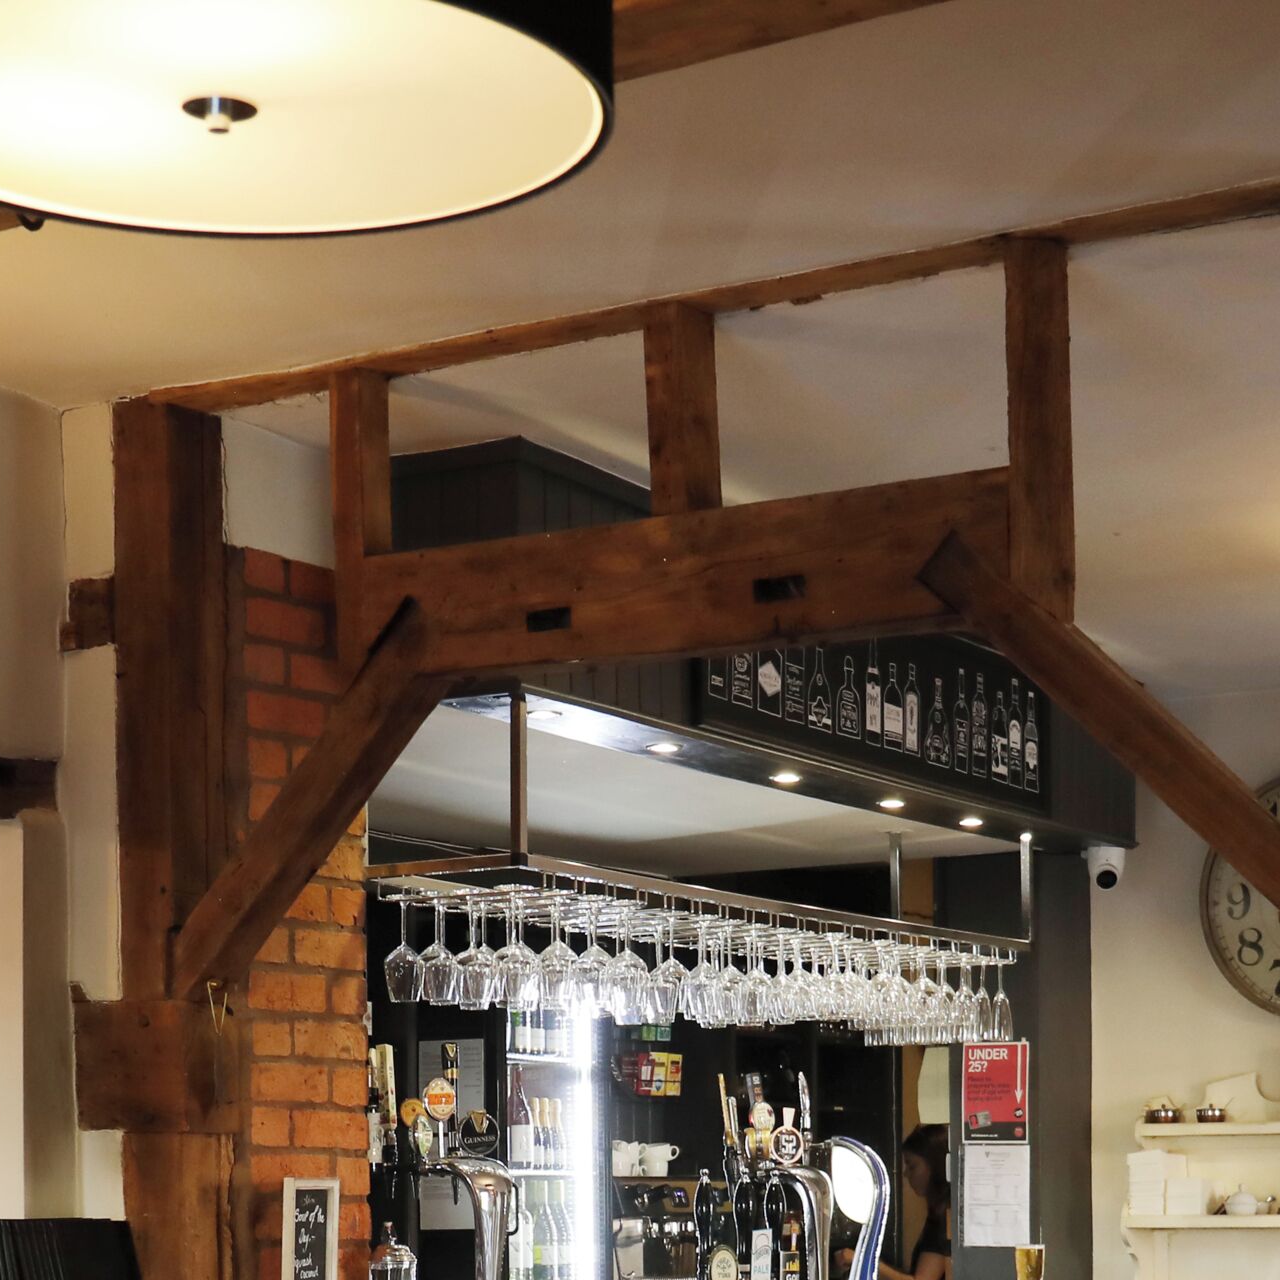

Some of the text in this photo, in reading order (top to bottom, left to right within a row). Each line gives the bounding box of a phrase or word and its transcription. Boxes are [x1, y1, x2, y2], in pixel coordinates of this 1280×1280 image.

[1227, 882, 1251, 920] 9
[1237, 927, 1264, 967] 8
[968, 1048, 1008, 1060] UNDER
[968, 1061, 988, 1073] 25?
[463, 1135, 496, 1145] GUINNESS
